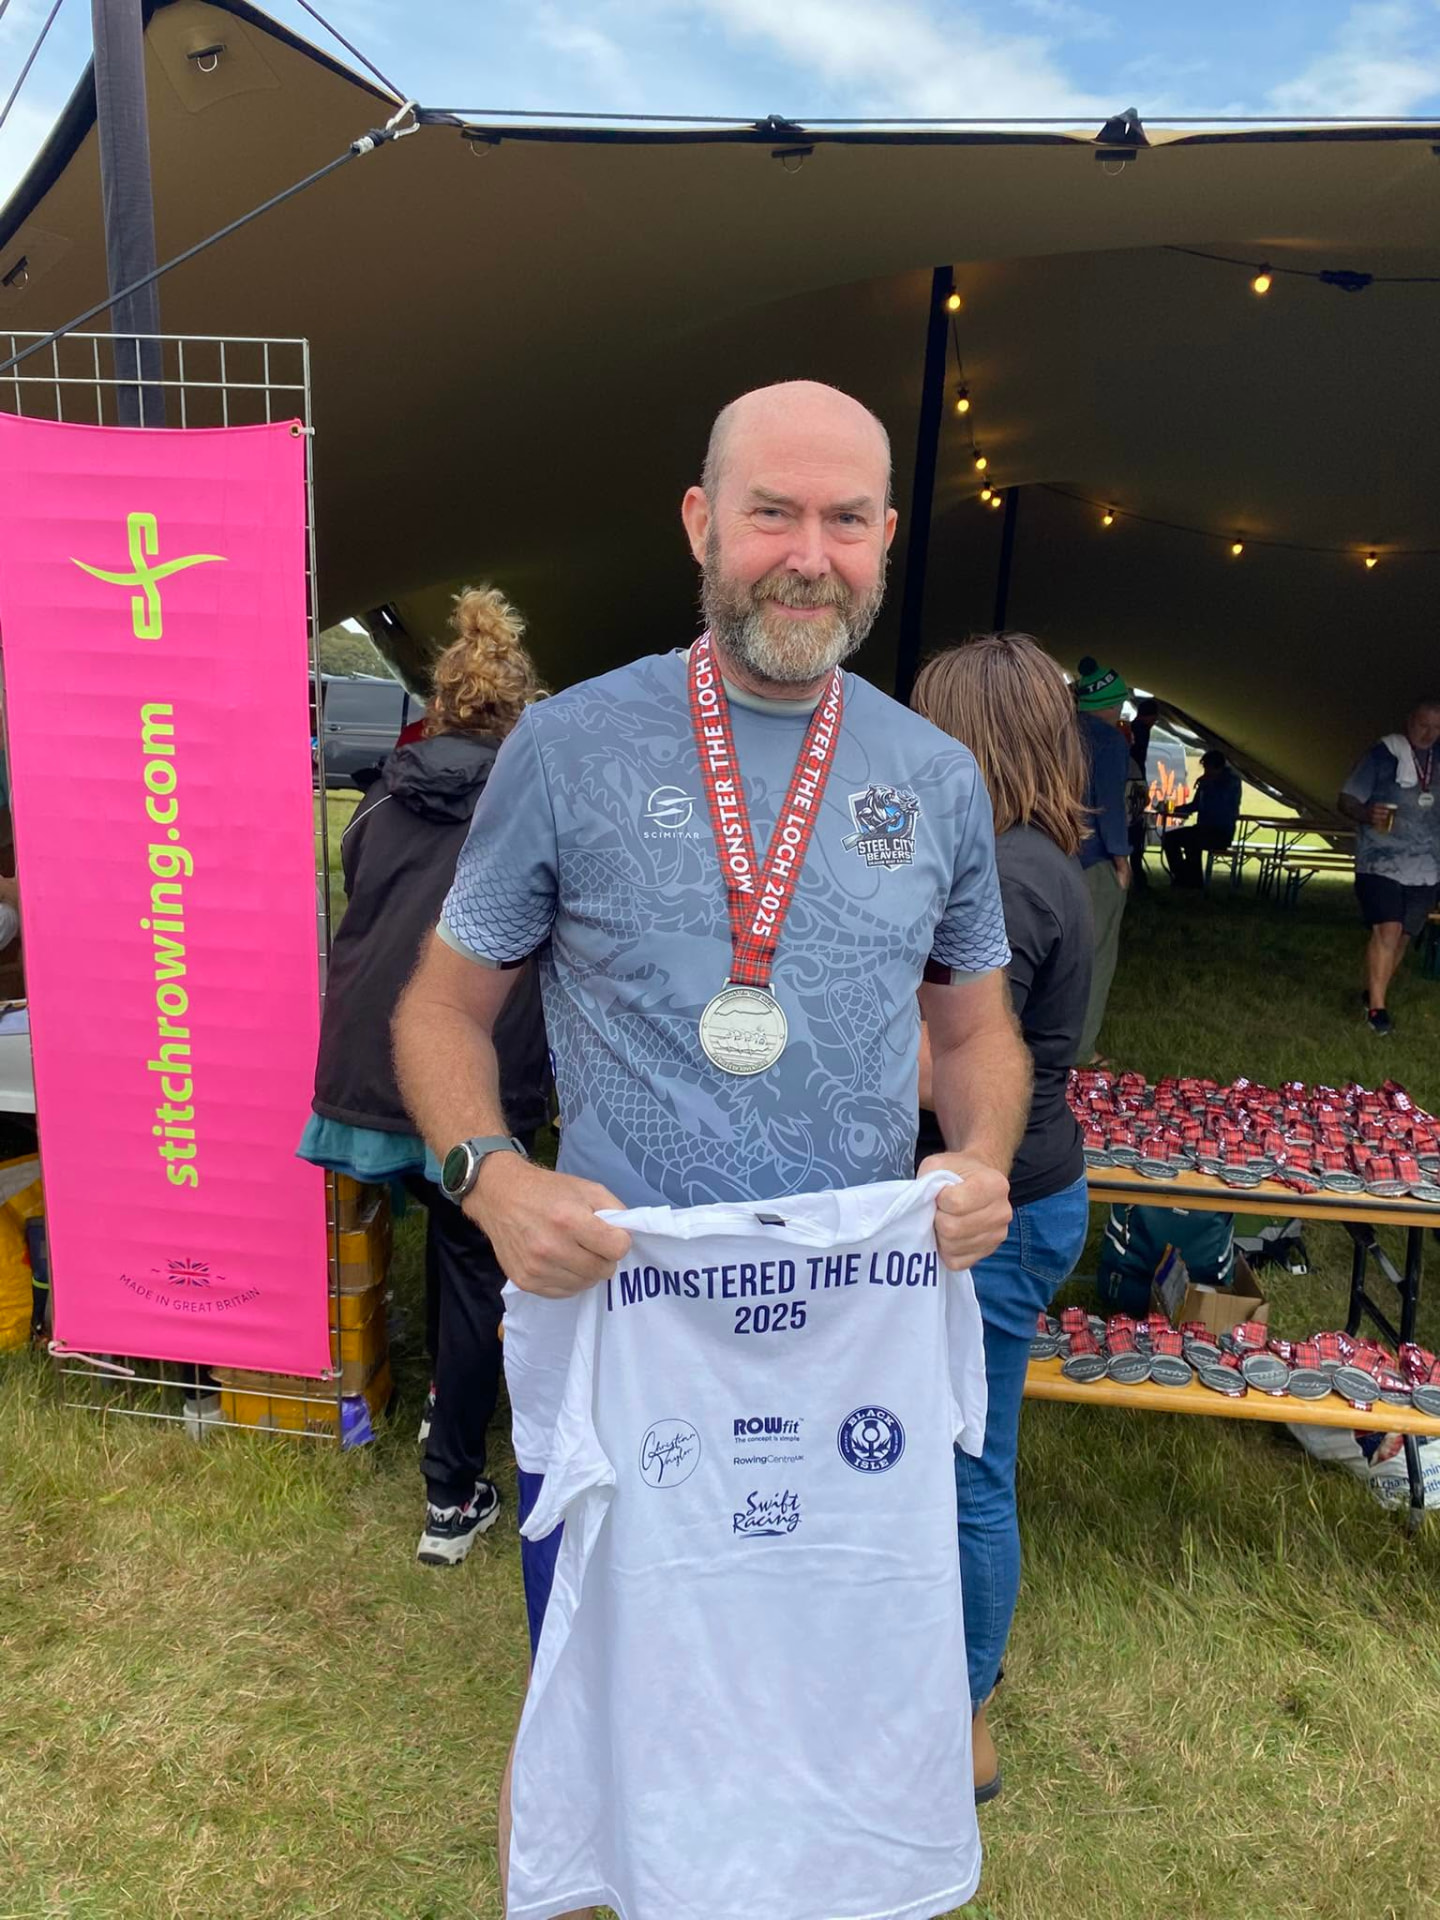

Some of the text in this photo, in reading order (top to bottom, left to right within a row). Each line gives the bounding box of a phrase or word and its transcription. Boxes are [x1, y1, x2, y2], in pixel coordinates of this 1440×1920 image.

[695, 658, 721, 718] LOCH
[703, 724, 731, 772] THE
[793, 767, 825, 810] THE
[643, 831, 700, 839] SCIMITAR
[721, 778, 755, 894] MONSTER
[770, 815, 805, 877] LOCH
[858, 838, 915, 853] STEEL CITY
[867, 851, 911, 861] BEAVERS
[751, 880, 784, 937] 2025
[140, 702, 198, 1188] stitchrowing.com
[119, 1274, 261, 1312] MADE IN GREAT BRITAIN
[607, 1250, 937, 1311] I MONSTERED THE LOCH
[734, 1301, 807, 1334] 2025
[847, 1409, 895, 1427] BLACK
[854, 1458, 889, 1470] ISLE
[746, 1489, 801, 1516] Swift
[733, 1511, 802, 1534] Racing
